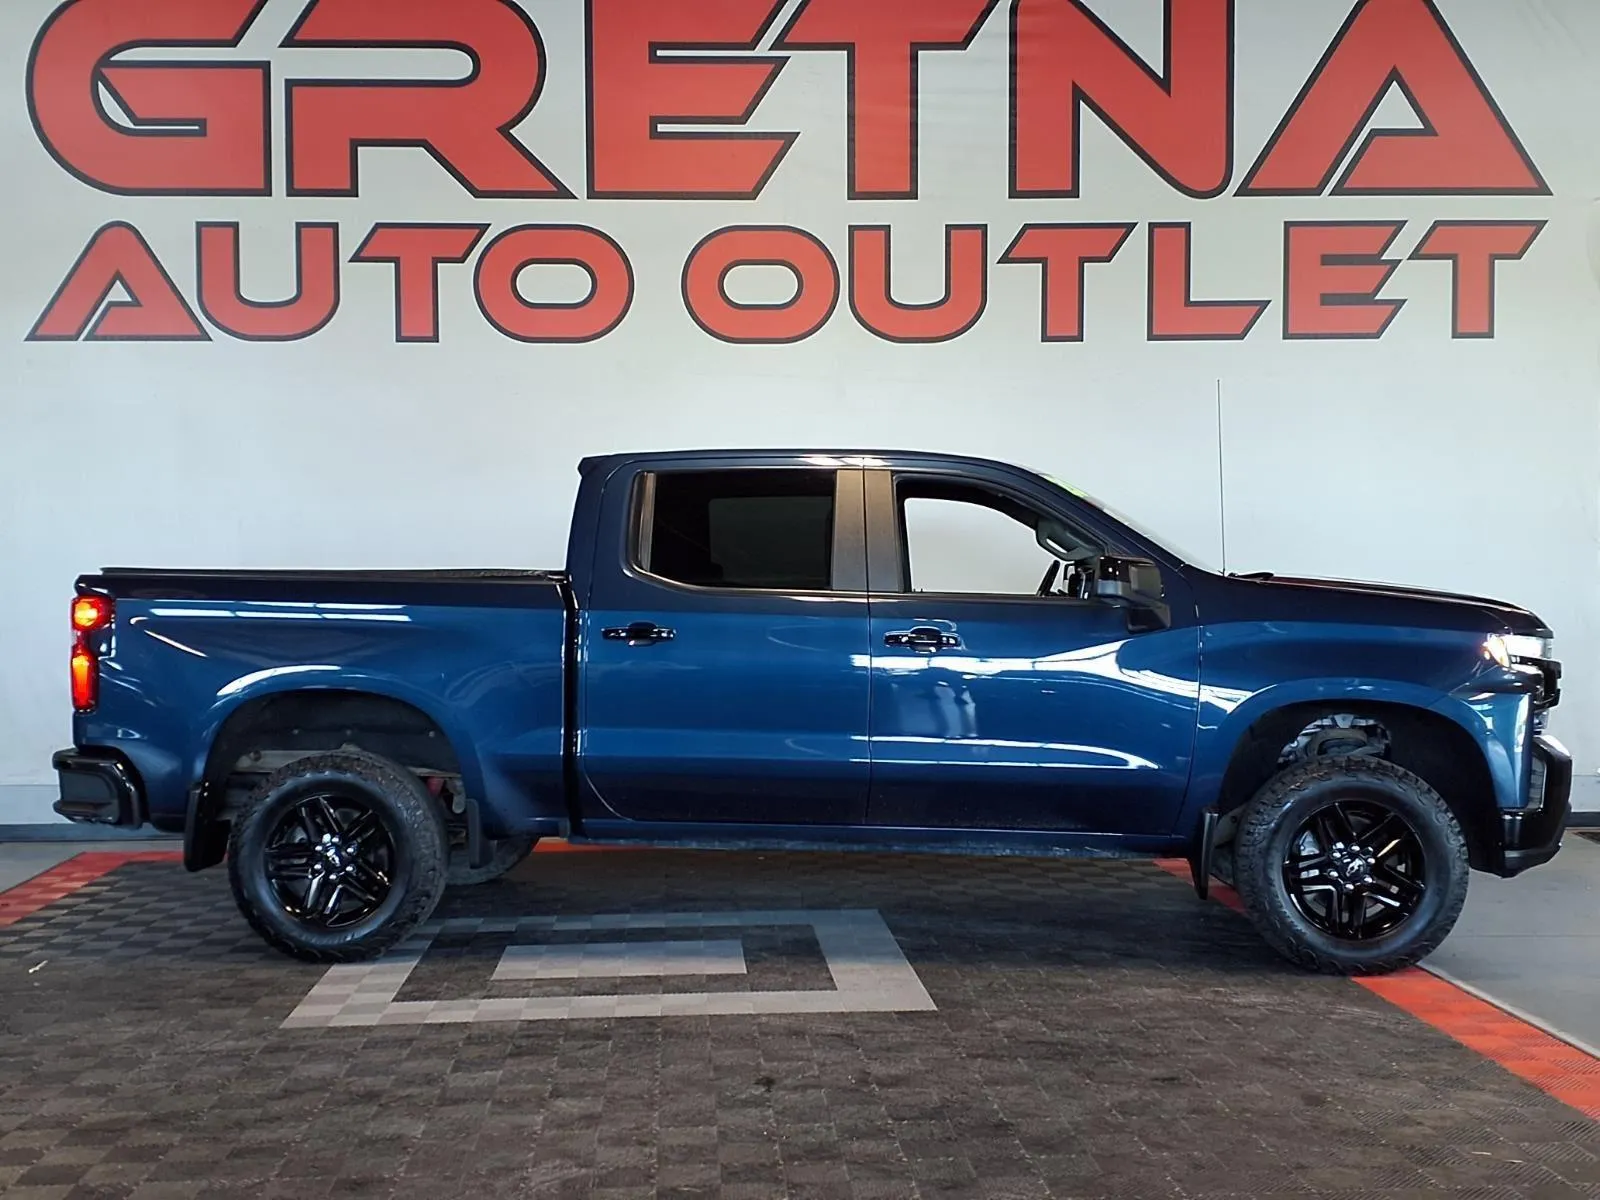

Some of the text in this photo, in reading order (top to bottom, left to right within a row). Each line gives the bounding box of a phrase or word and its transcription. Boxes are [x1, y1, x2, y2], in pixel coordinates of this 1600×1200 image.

[26, 0, 1553, 200] GRETNA
[24, 219, 1549, 344] AUTO OUTLET
